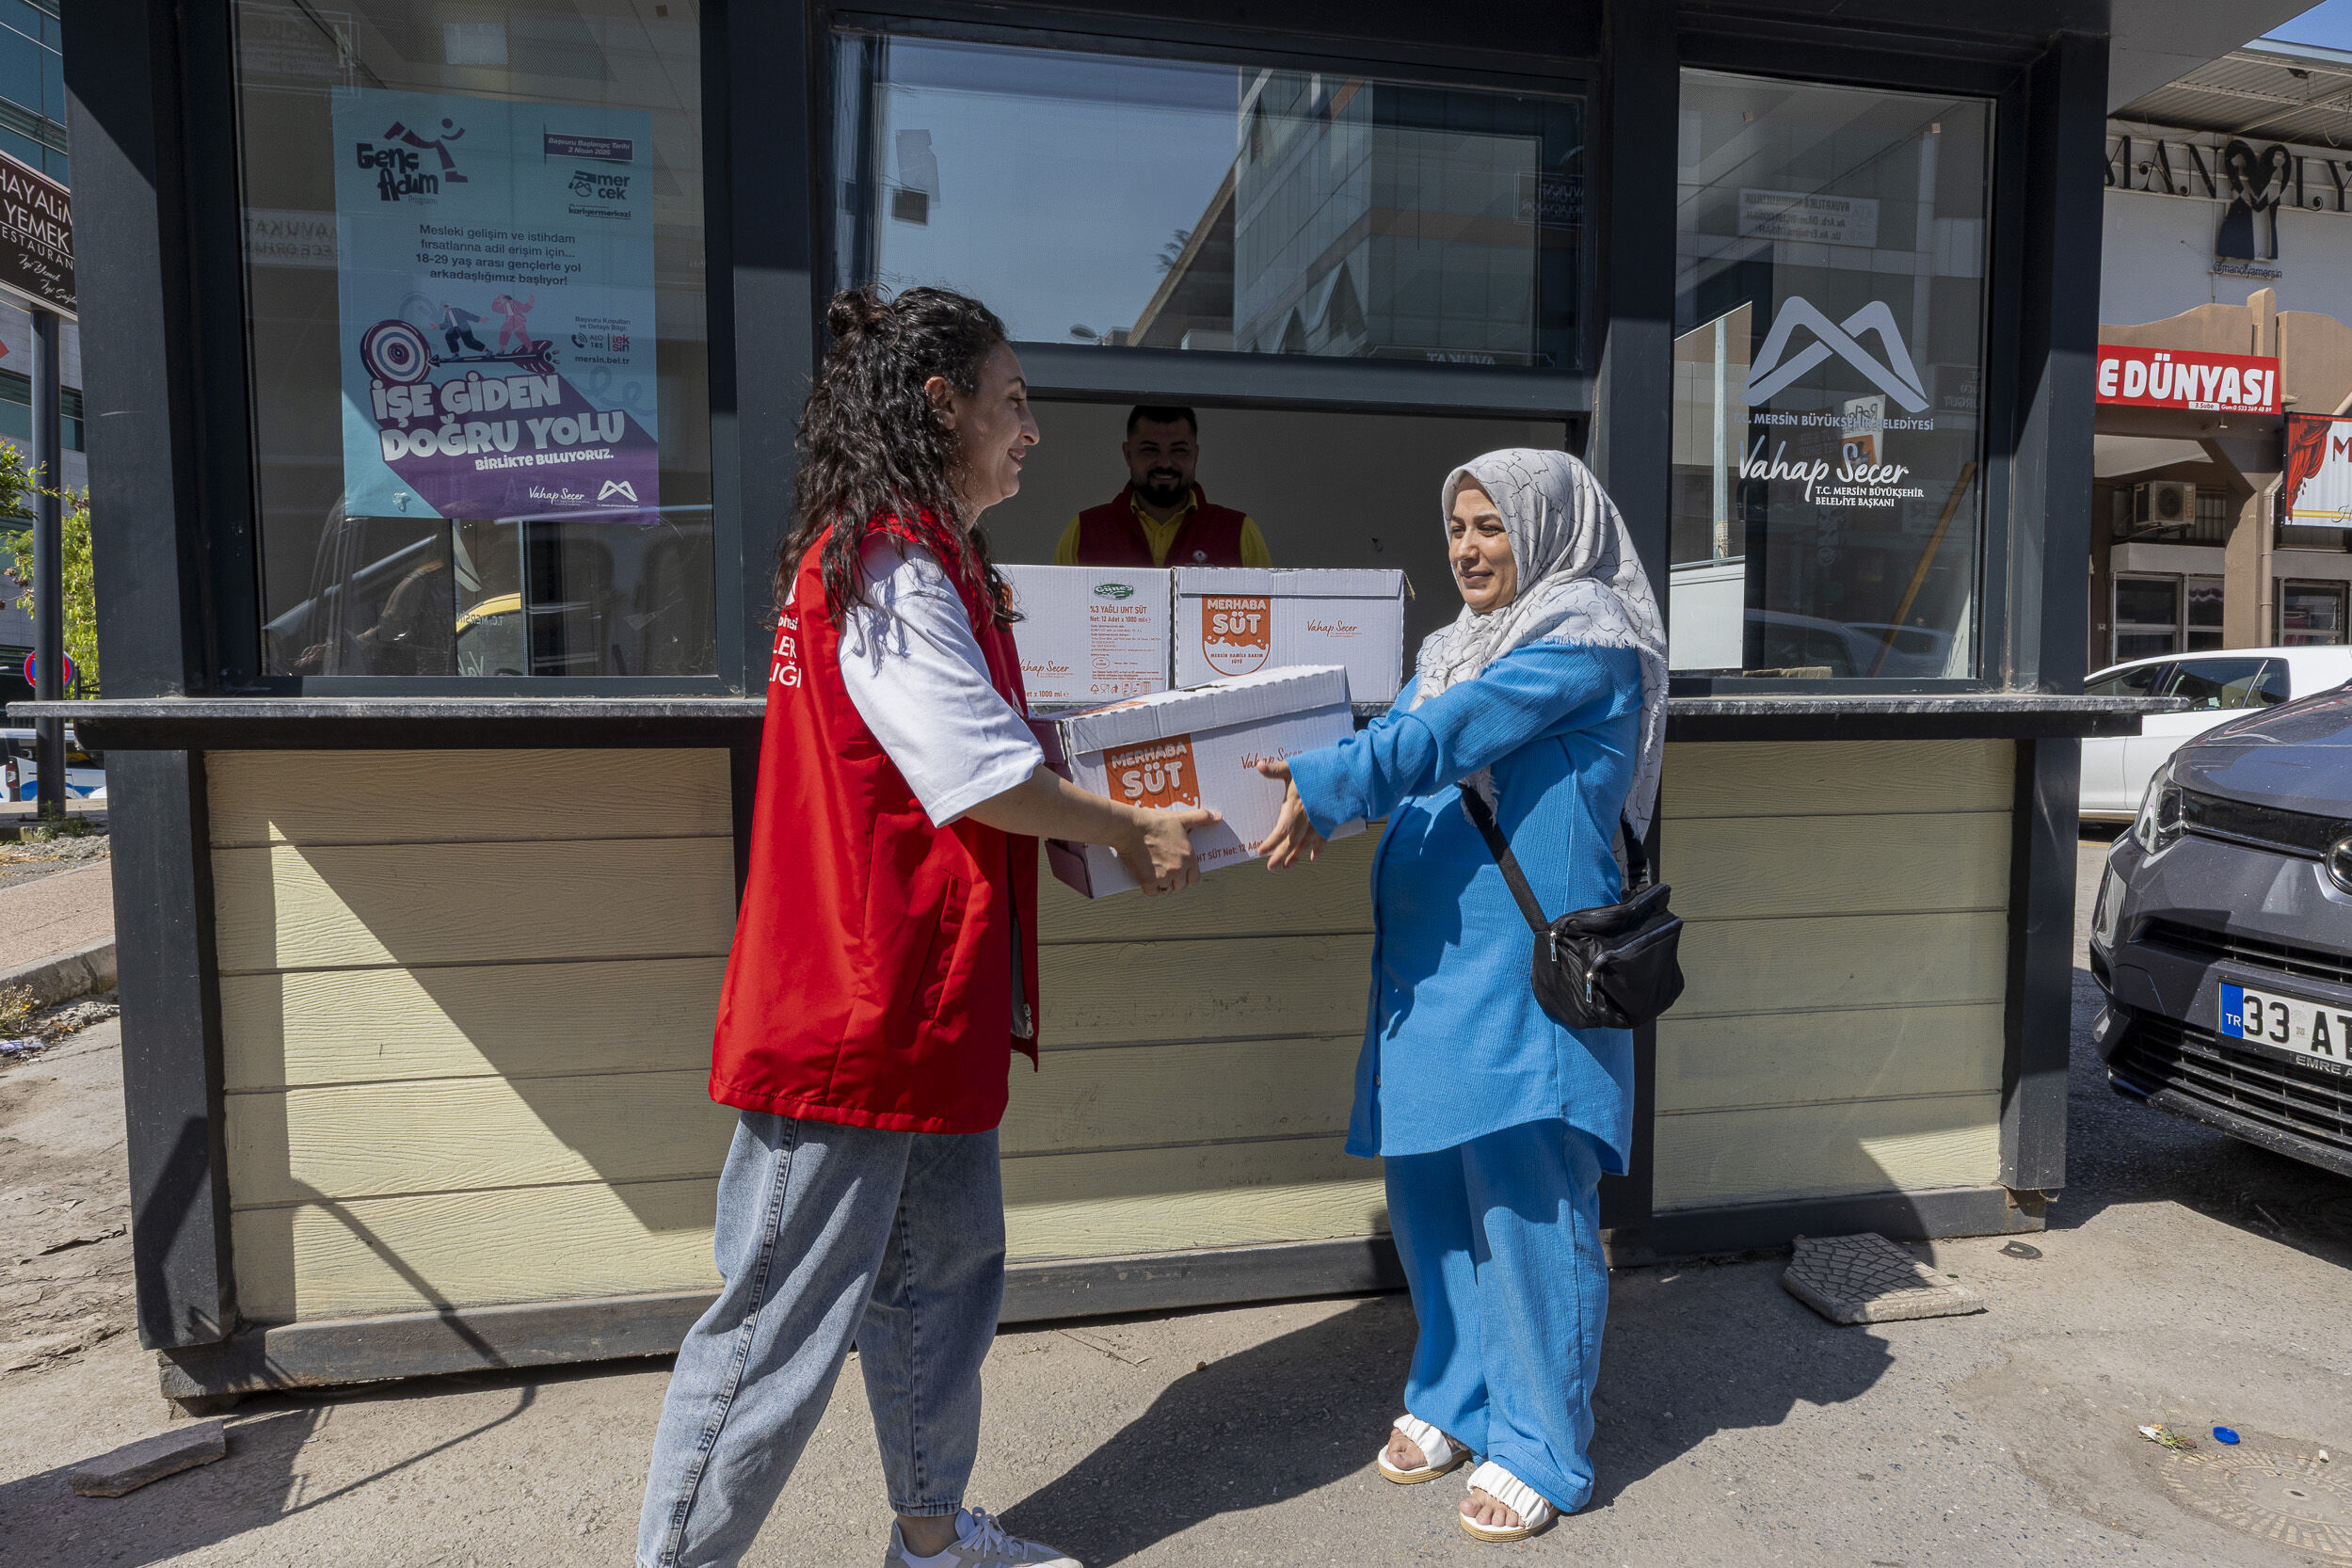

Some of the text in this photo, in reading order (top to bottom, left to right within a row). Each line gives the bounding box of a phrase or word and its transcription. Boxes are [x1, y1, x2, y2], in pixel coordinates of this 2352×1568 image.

[357, 143, 420, 174] Genç
[376, 168, 439, 201] Adım
[598, 187, 627, 200] cek
[4, 199, 70, 253] YEMEK
[420, 224, 575, 244] Mesleki gelişim ve istihdam
[421, 239, 575, 259] fırsatlarına adil erişim için...
[415, 253, 582, 274] 18-29 yaş arası gençlerle yol
[430, 269, 568, 286] arkadaşlığımız başlıyor!
[575, 356, 630, 364] mersin.bel.tr
[2123, 353, 2275, 407] DÜNYASI
[372, 371, 561, 427] İŞE GİDEN
[1733, 413, 1752, 424] T.C.
[1754, 412, 1799, 425] MERSİN
[381, 410, 625, 461] DOĞRU YOLU
[536, 448, 614, 466] BULUYORUZ.
[1739, 434, 1830, 503] Vahap
[1836, 442, 1909, 487] Seçer
[529, 485, 559, 505] Vahap
[1816, 485, 1924, 499] T.C. MERSİN BÜYÜKŞEHİR
[1858, 498, 1895, 508] BAŞKANI
[1090, 603, 1147, 615] %3 YAĞLI UHT SÜT
[1208, 599, 1267, 610] MERHABA
[1212, 611, 1261, 634] SÜT
[1306, 618, 1335, 637] Vahap
[1112, 741, 1187, 769] MERHABA
[1122, 760, 1182, 797] SÜT
[1208, 848, 1222, 860] SÜT
[1224, 847, 1237, 857] Net:
[1239, 843, 1246, 853] 12
[2226, 1014, 2242, 1028] TR
[2243, 995, 2290, 1044] 33
[2296, 1055, 2342, 1076] EMRE
